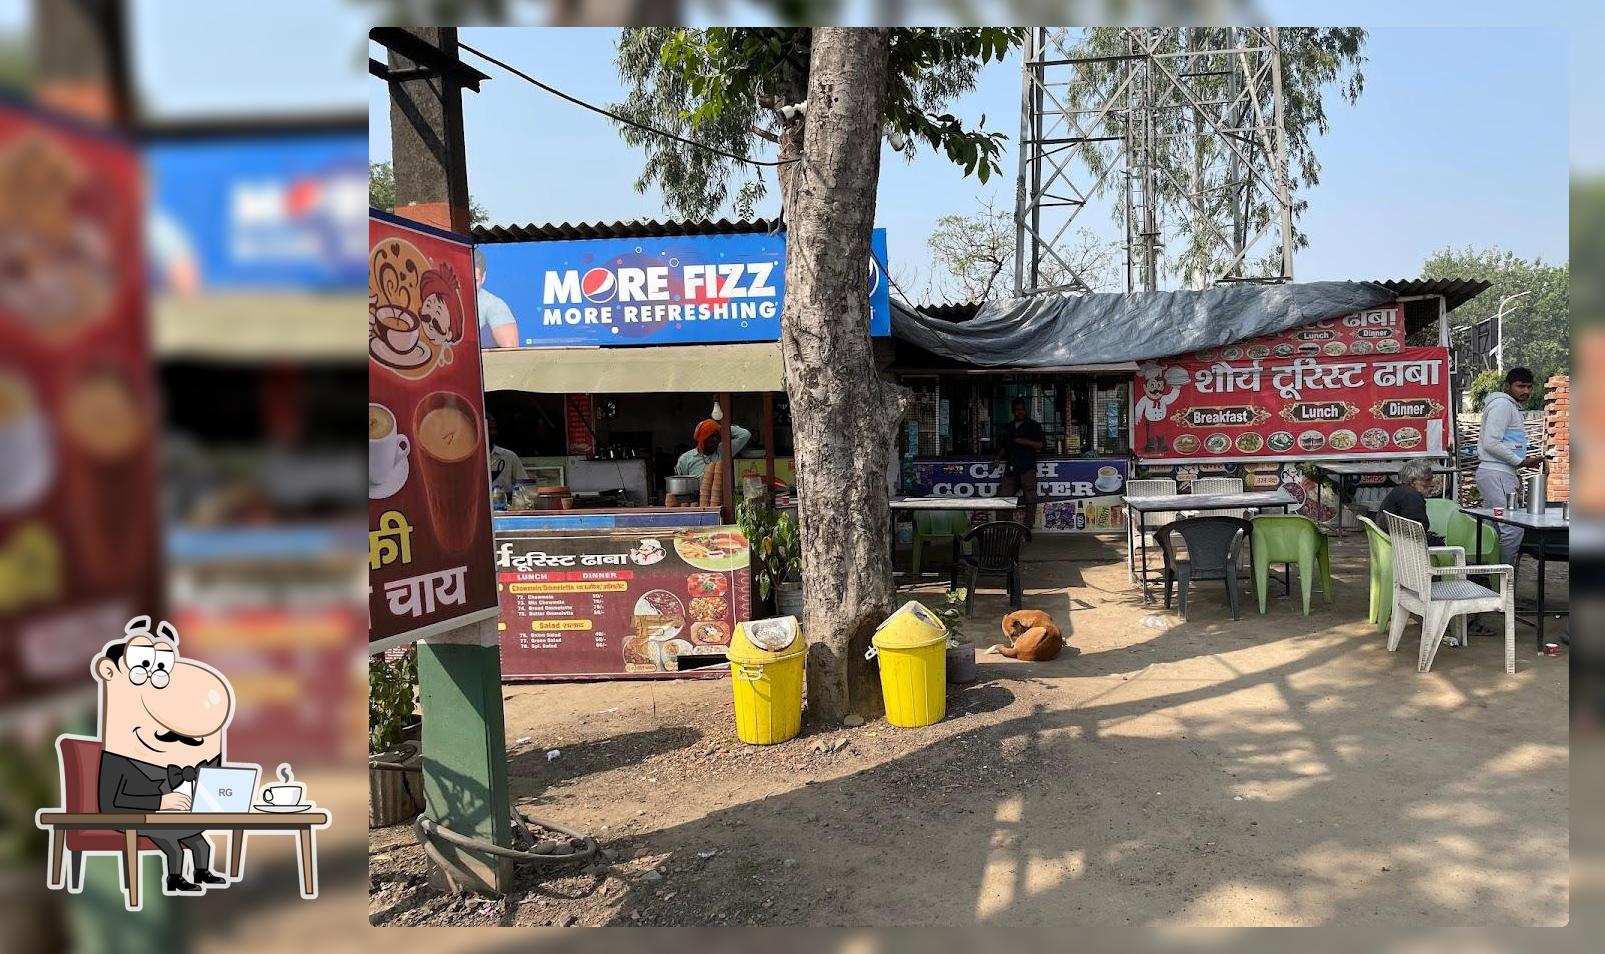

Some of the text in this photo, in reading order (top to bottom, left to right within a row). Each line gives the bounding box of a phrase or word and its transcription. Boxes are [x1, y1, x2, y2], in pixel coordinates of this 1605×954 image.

[543, 261, 776, 304] MORE FIZZ
[543, 302, 777, 326] MORE REFRESHING
[1304, 328, 1388, 340] Lunch Dinner
[1373, 359, 1442, 387] ढाबा
[1193, 402, 1425, 424] Breakfast Lunch Dinner
[969, 463, 1058, 479] CAH
[932, 481, 1096, 498] COUTER
[384, 566, 468, 617] चाय
